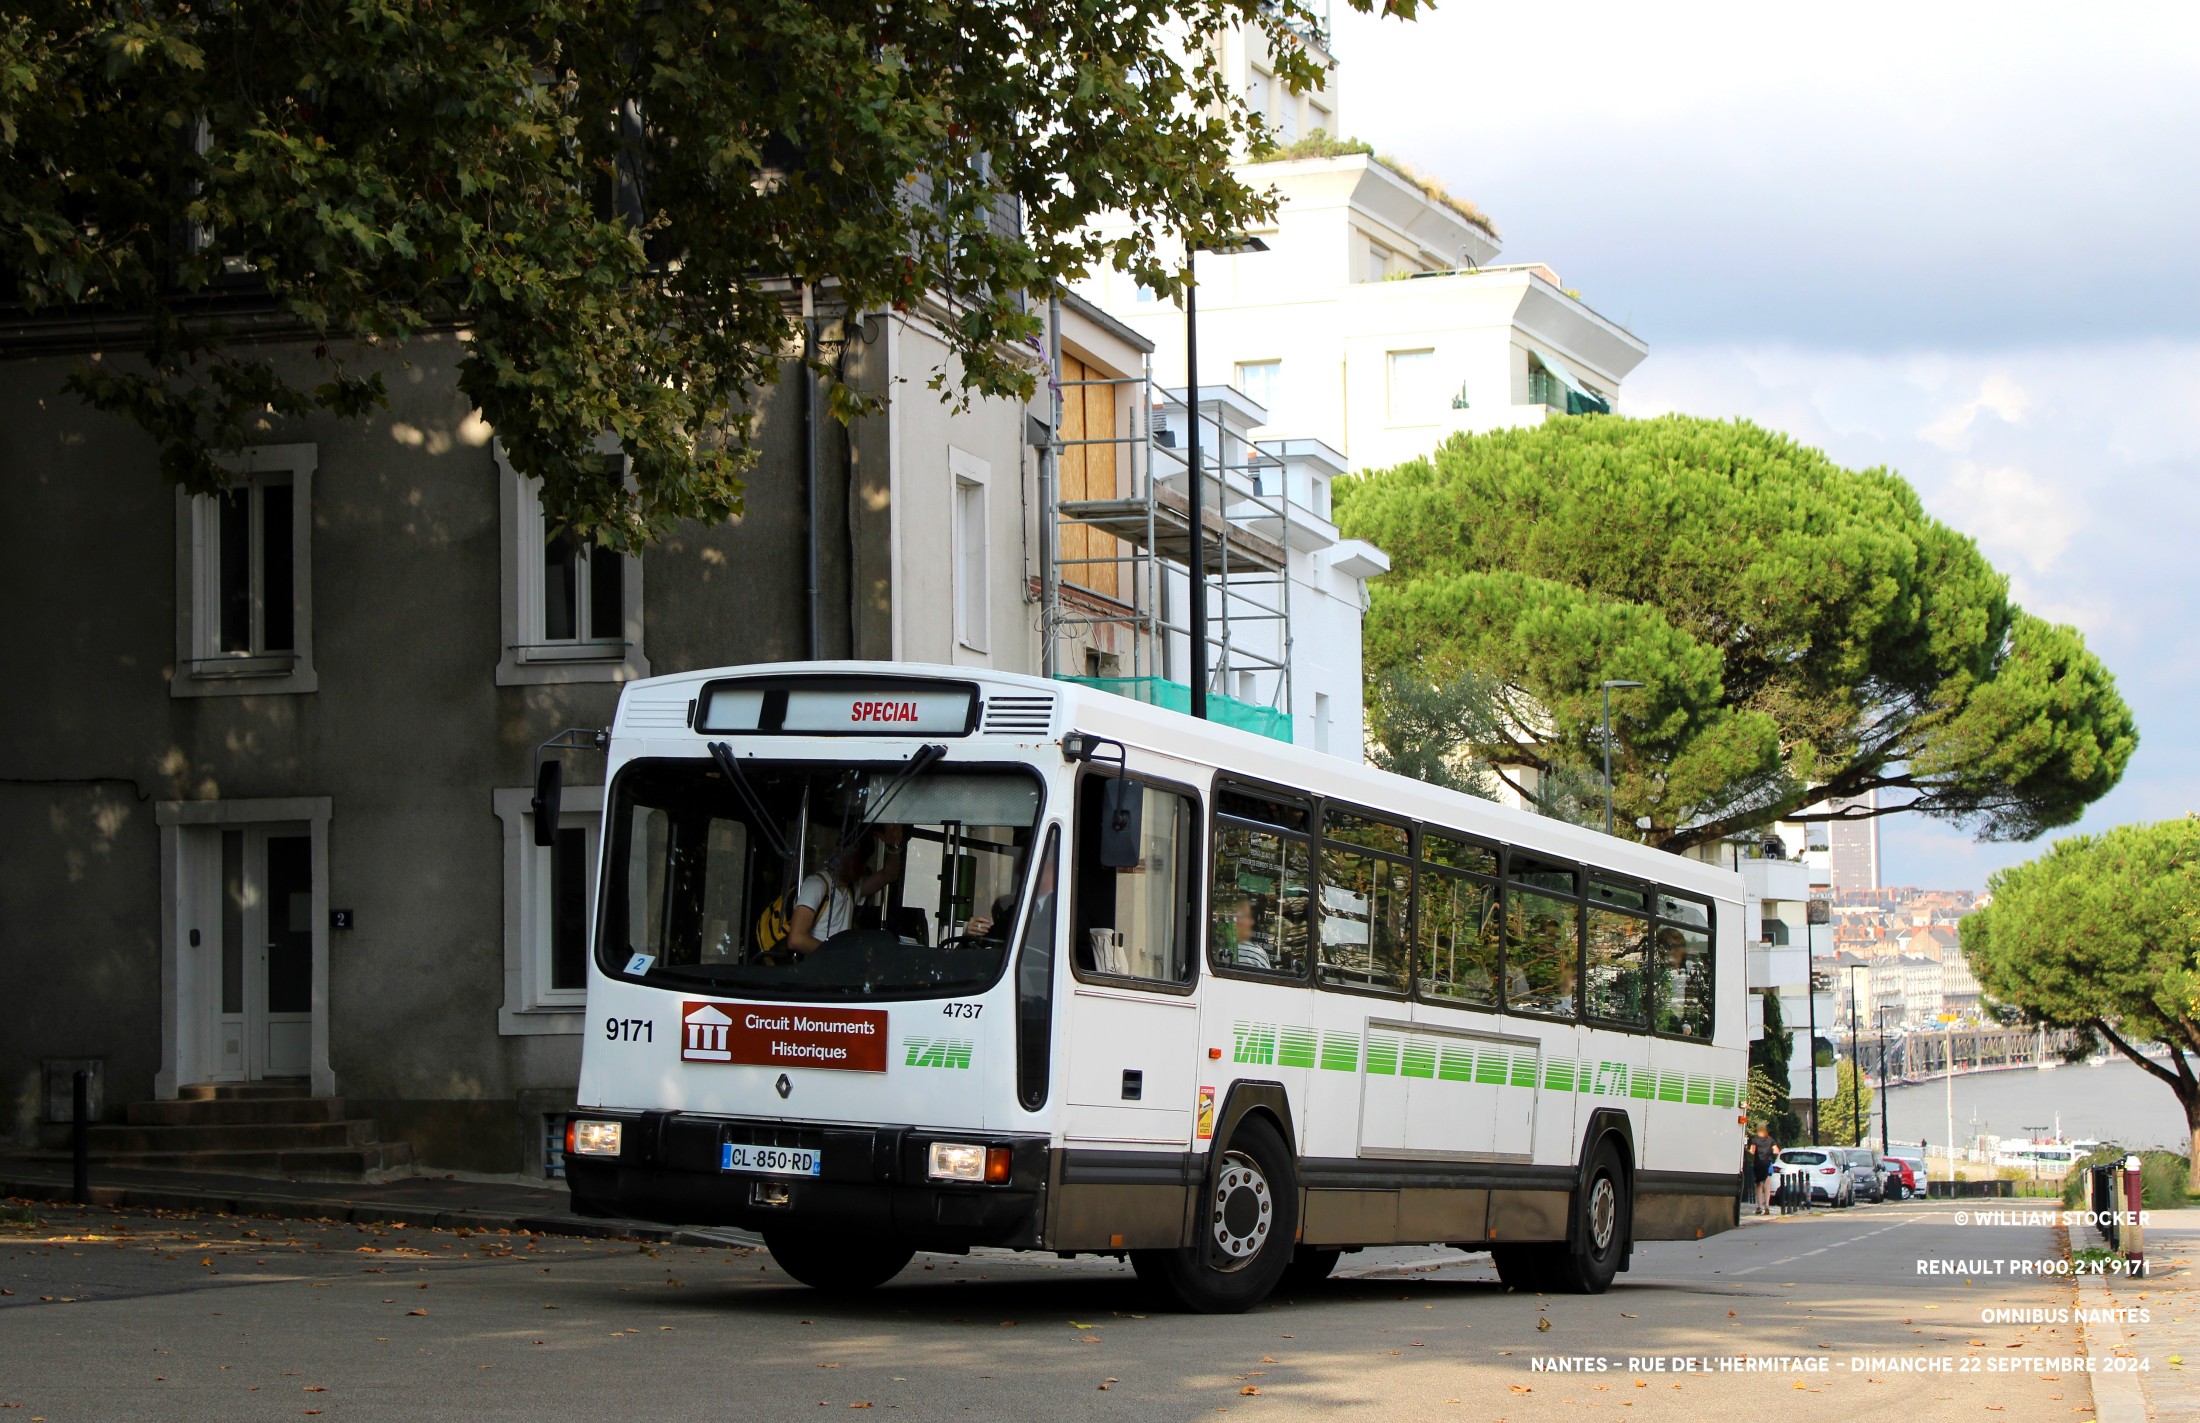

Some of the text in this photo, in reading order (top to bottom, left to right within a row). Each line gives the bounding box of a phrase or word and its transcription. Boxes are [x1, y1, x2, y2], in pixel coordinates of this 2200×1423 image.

[851, 701, 919, 722] SPECIAL
[337, 912, 345, 927] 2
[633, 957, 646, 971] 2
[943, 1003, 984, 1019] 4737
[606, 1017, 654, 1043] 9171
[745, 1014, 875, 1035] Circuit Monuments
[771, 1041, 847, 1060] Historiques
[902, 1035, 975, 1070] TAN
[1232, 1019, 1277, 1066] TAN
[1593, 1061, 1628, 1097] CTA
[731, 1148, 812, 1171] CL-850-RD
